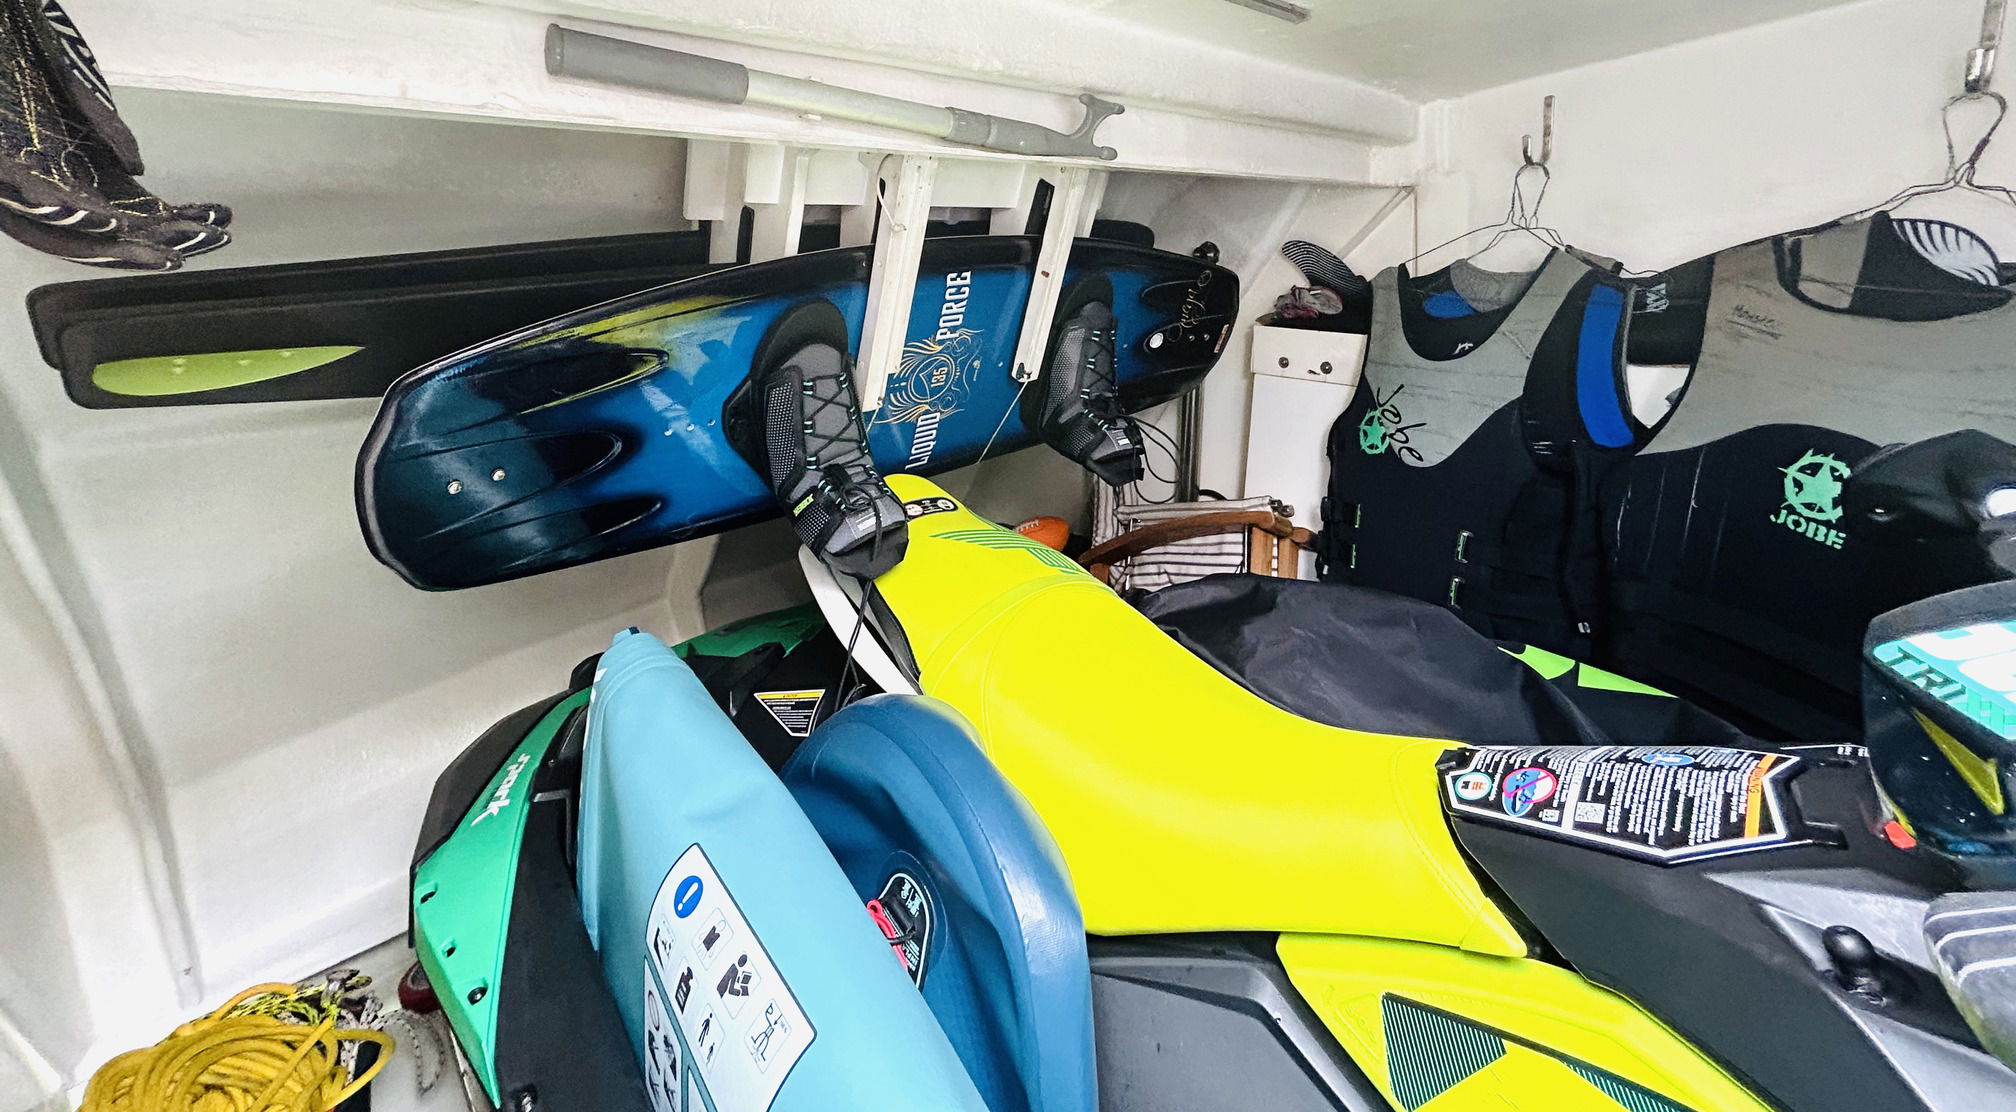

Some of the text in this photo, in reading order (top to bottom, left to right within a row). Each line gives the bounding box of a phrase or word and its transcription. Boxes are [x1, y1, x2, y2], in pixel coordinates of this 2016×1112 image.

[905, 411, 941, 470] LIQUID
[935, 271, 971, 342] FORCE
[930, 366, 948, 388] 135
[1377, 383, 1428, 462] Jobe
[1769, 509, 1847, 550] JOBE
